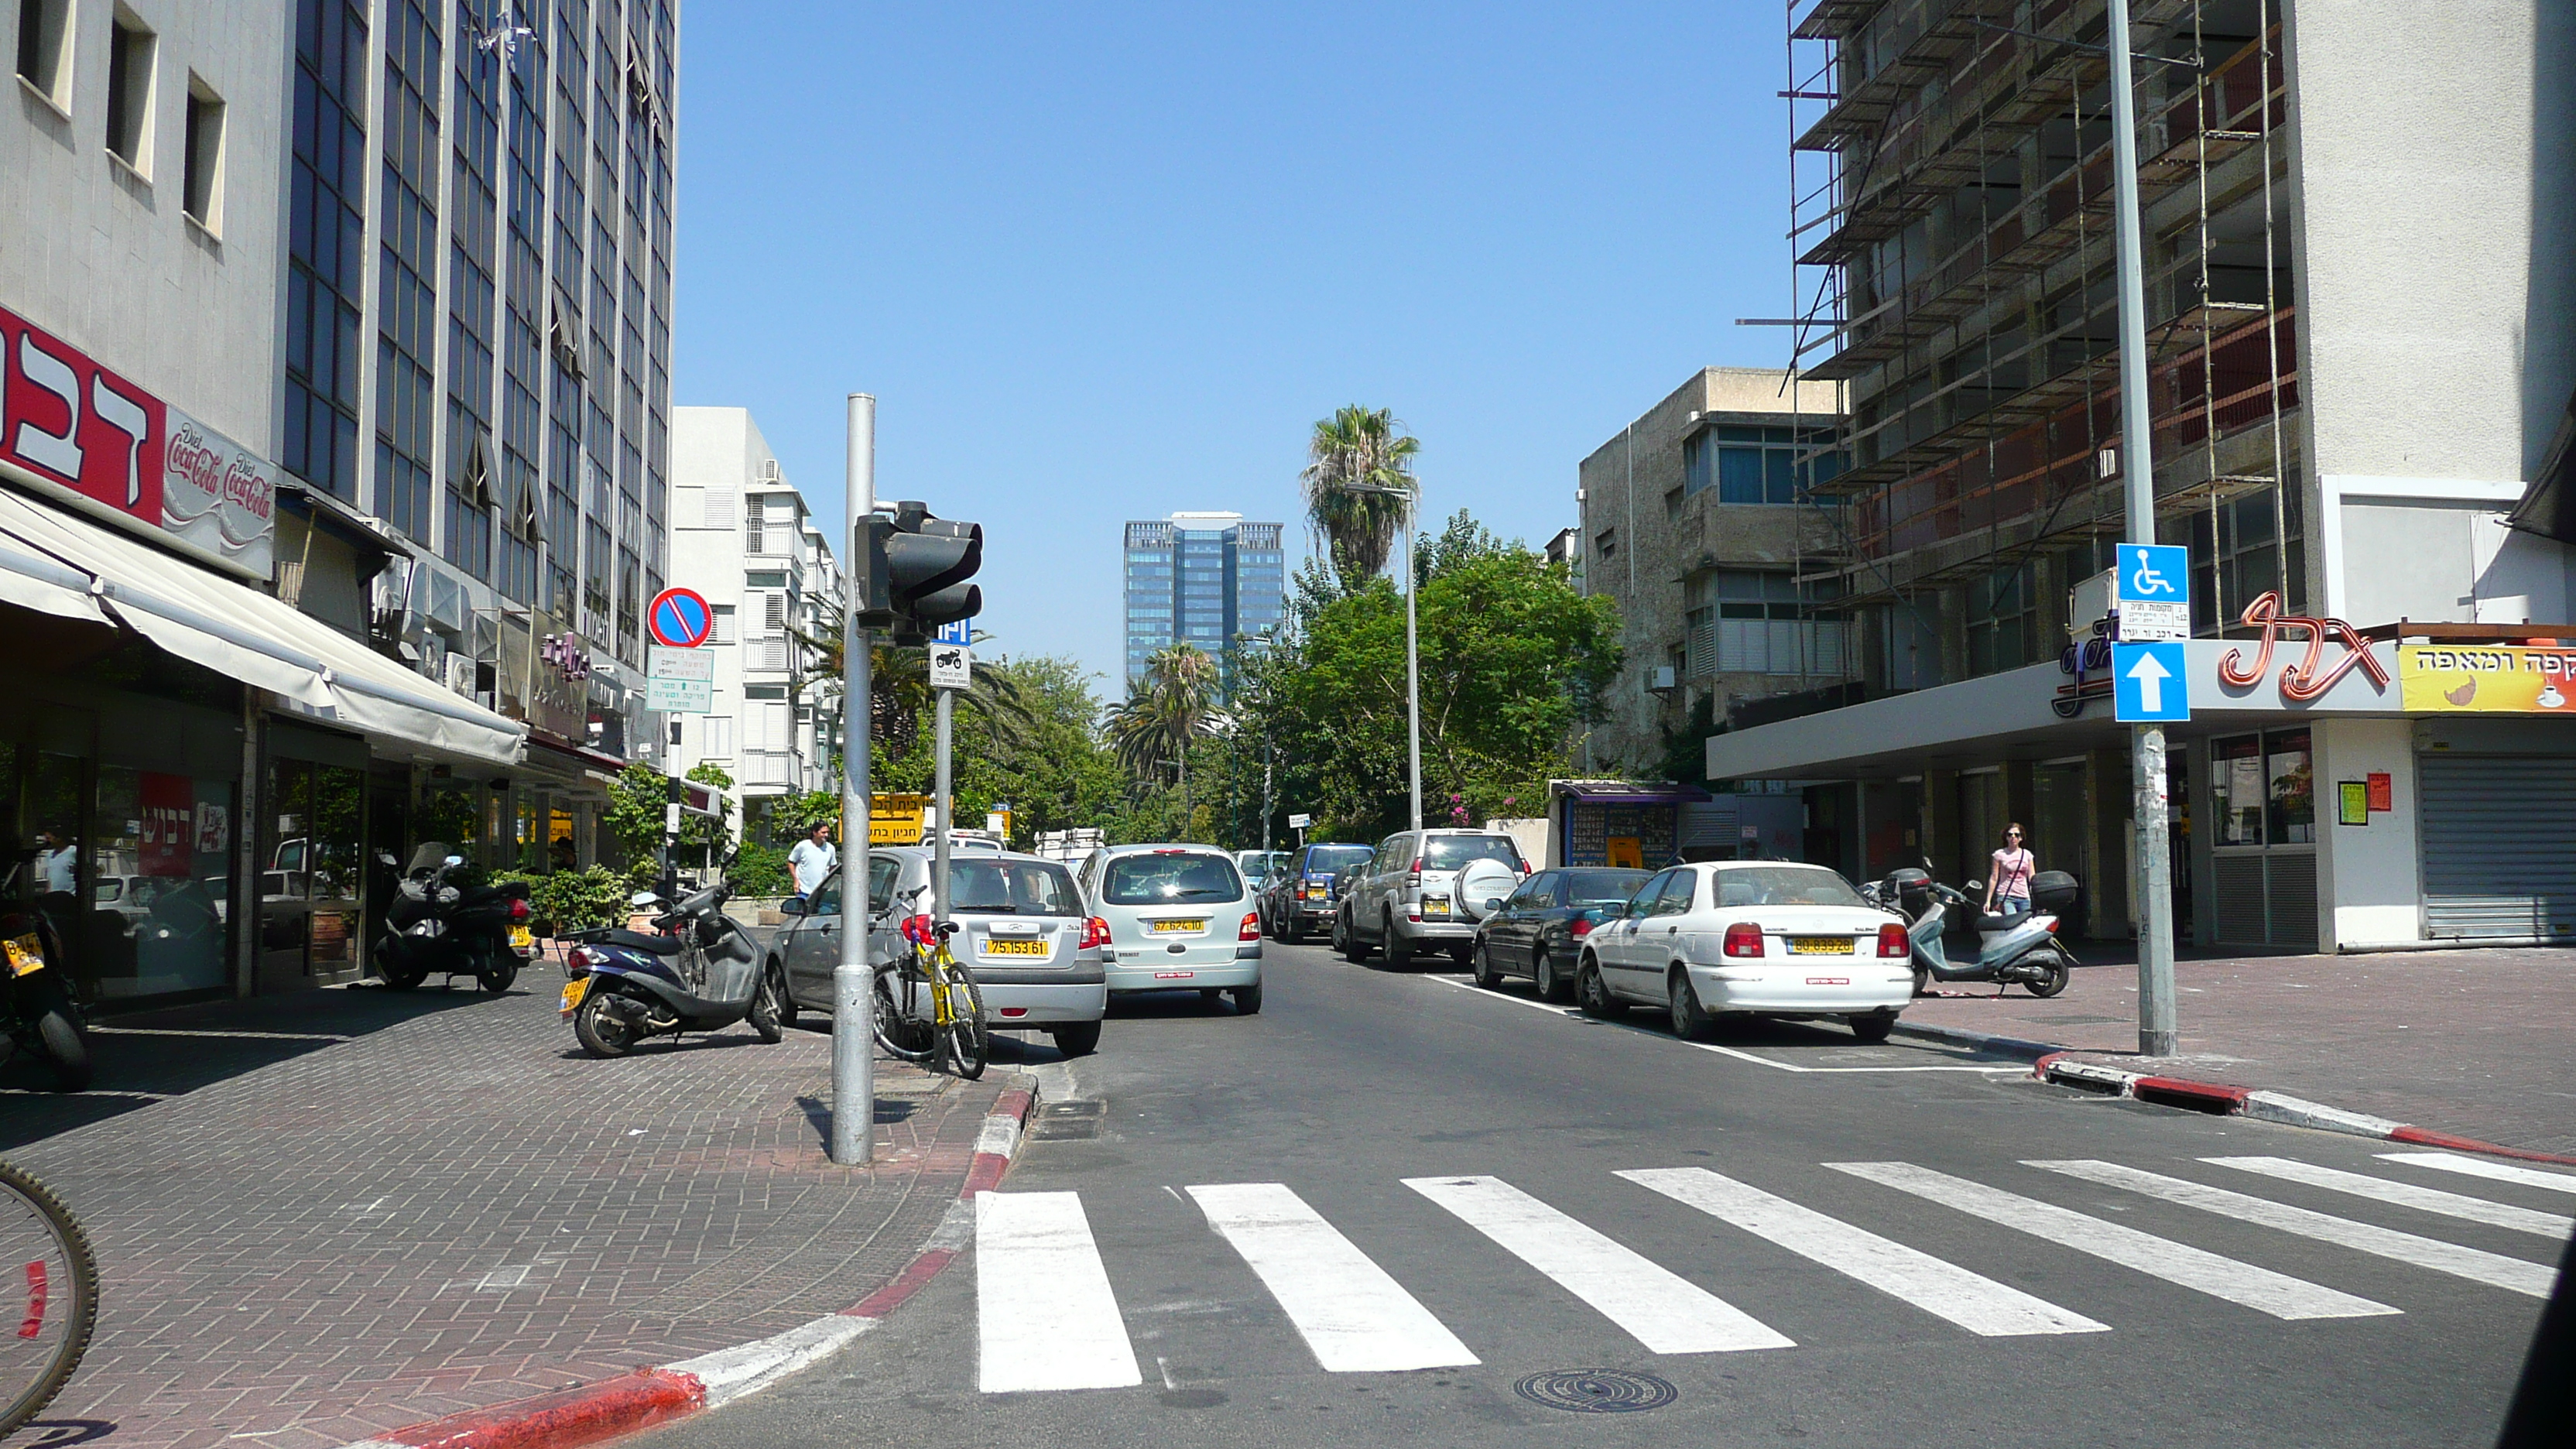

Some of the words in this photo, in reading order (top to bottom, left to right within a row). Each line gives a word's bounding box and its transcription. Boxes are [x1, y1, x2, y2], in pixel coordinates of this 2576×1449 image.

[0, 327, 149, 508] דב
[182, 423, 203, 450] Diet
[237, 454, 255, 478] Diet
[2416, 651, 2515, 673] ומאפה
[898, 801, 916, 810] בית
[142, 806, 190, 843] דבוש
[893, 828, 916, 838] חניון
